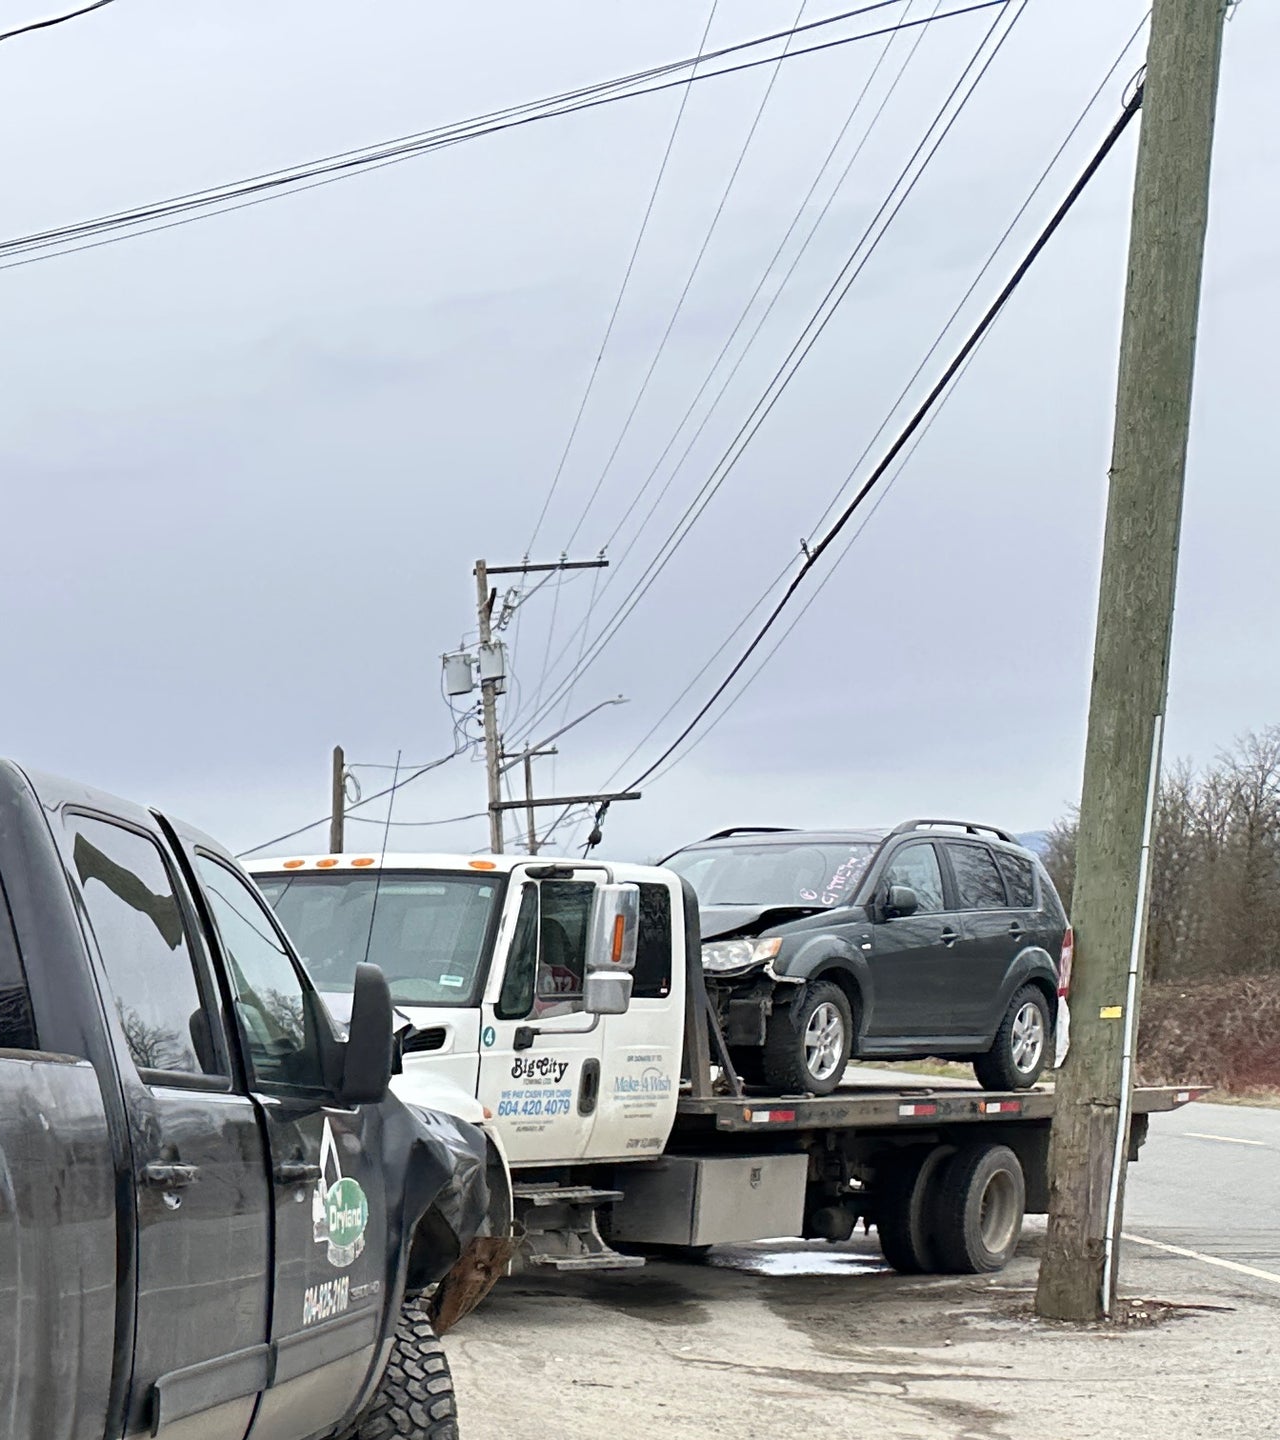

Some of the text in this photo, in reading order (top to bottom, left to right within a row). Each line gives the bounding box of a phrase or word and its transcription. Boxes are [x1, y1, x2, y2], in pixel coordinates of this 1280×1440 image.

[484, 1028, 493, 1044] 4
[498, 1099, 571, 1116] 604.420.4079
[329, 1202, 362, 1234] Dryland
